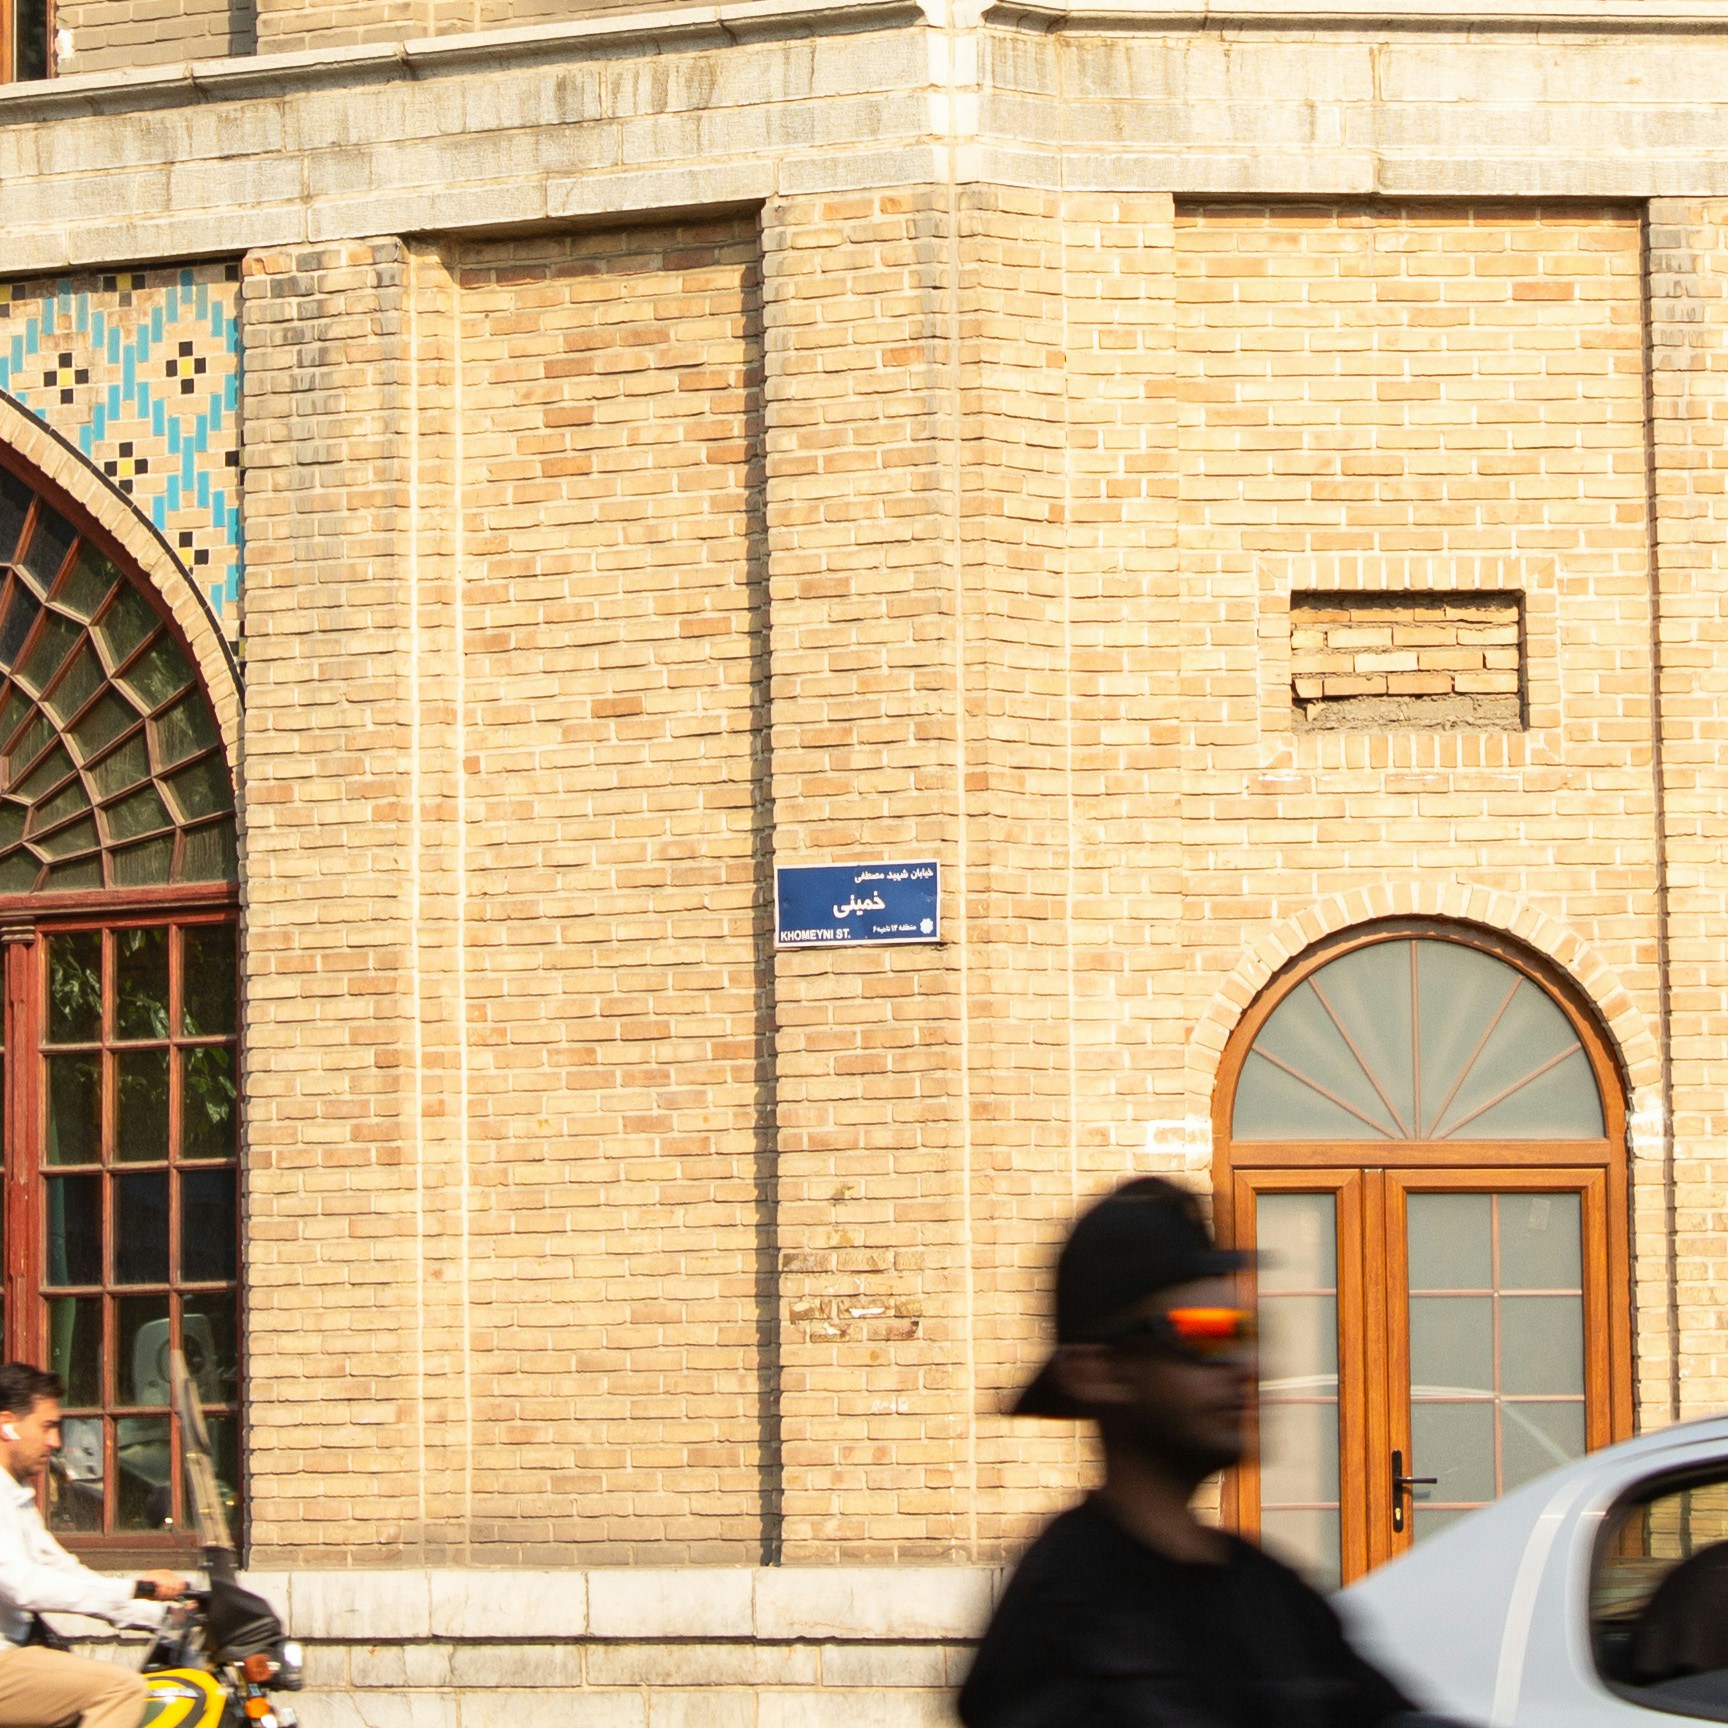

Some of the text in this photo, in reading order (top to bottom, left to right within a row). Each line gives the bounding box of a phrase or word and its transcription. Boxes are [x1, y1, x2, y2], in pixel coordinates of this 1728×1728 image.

[854, 867, 934, 884] خیابان شهید مصطفی
[832, 890, 886, 919] خمینی
[780, 927, 851, 942] KHOMEYNI ST.
